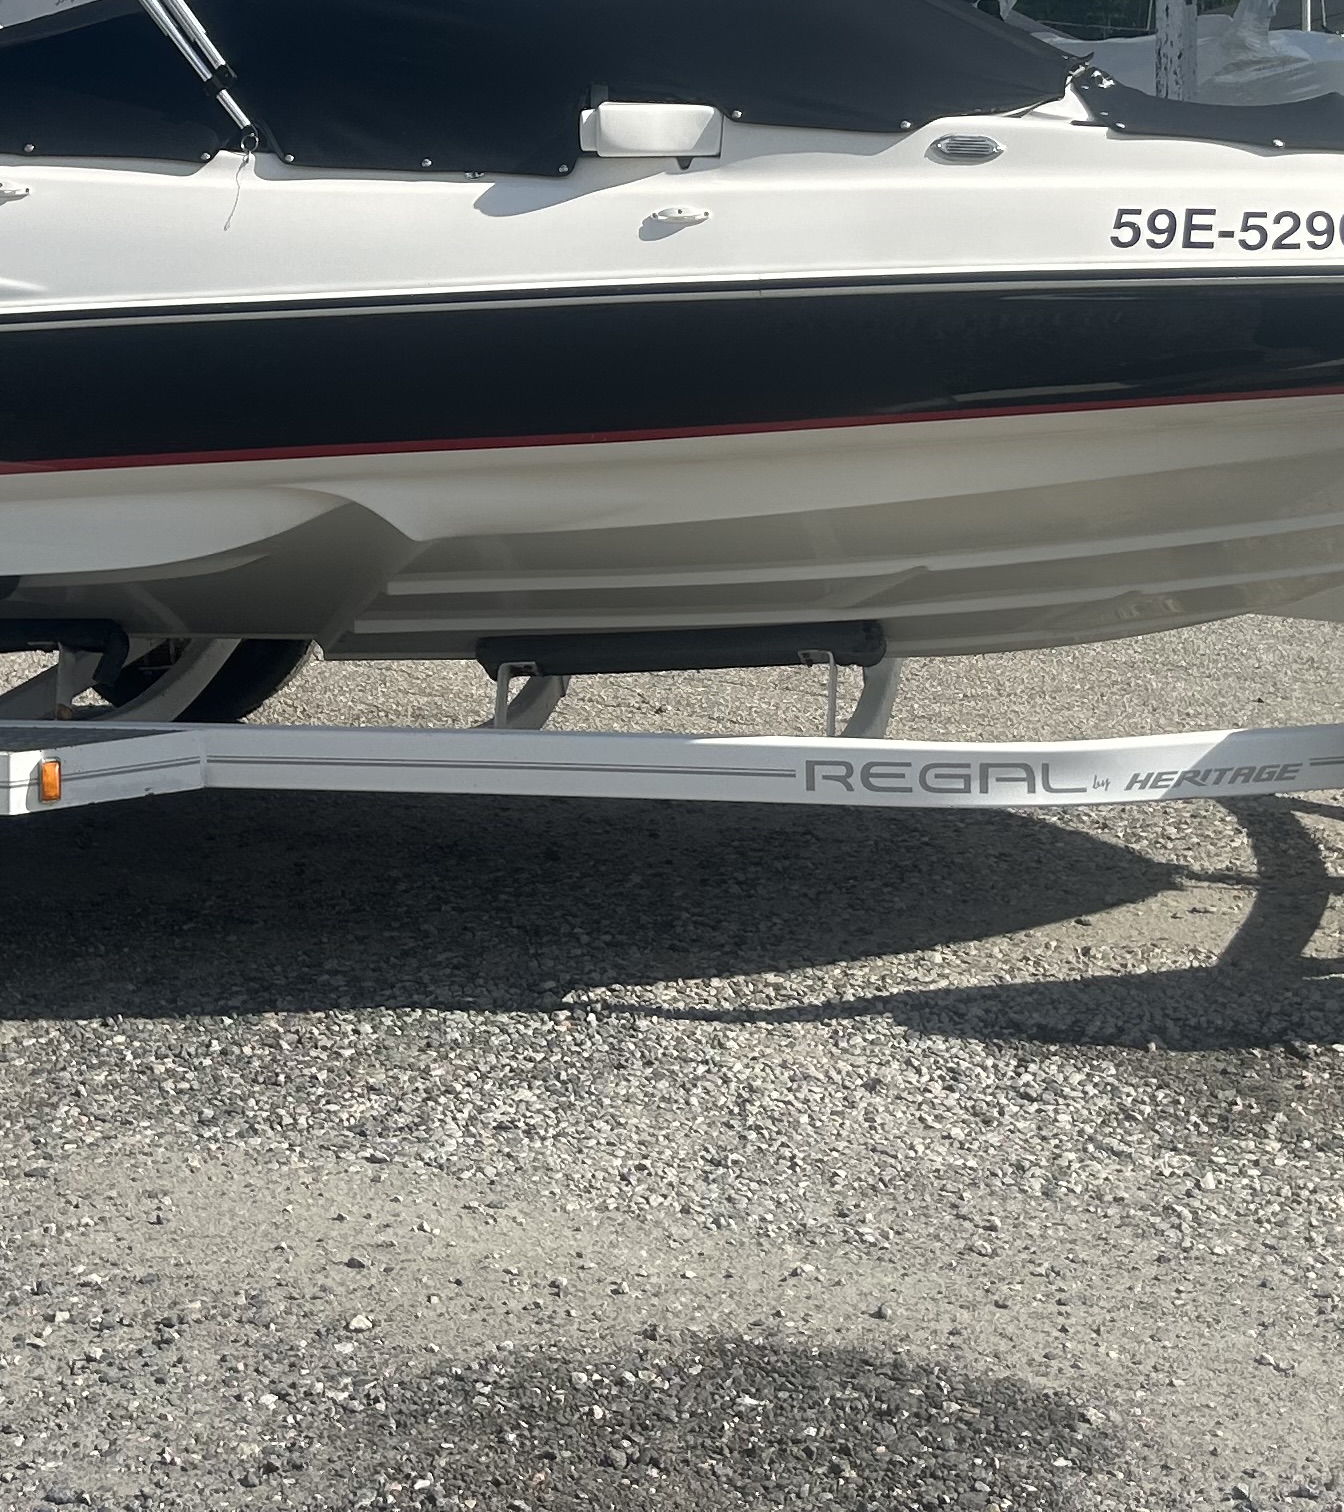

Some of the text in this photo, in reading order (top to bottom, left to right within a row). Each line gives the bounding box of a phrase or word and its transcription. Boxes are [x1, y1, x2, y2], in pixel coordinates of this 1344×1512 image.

[805, 759, 1304, 795] REGAL by HERITAGE
